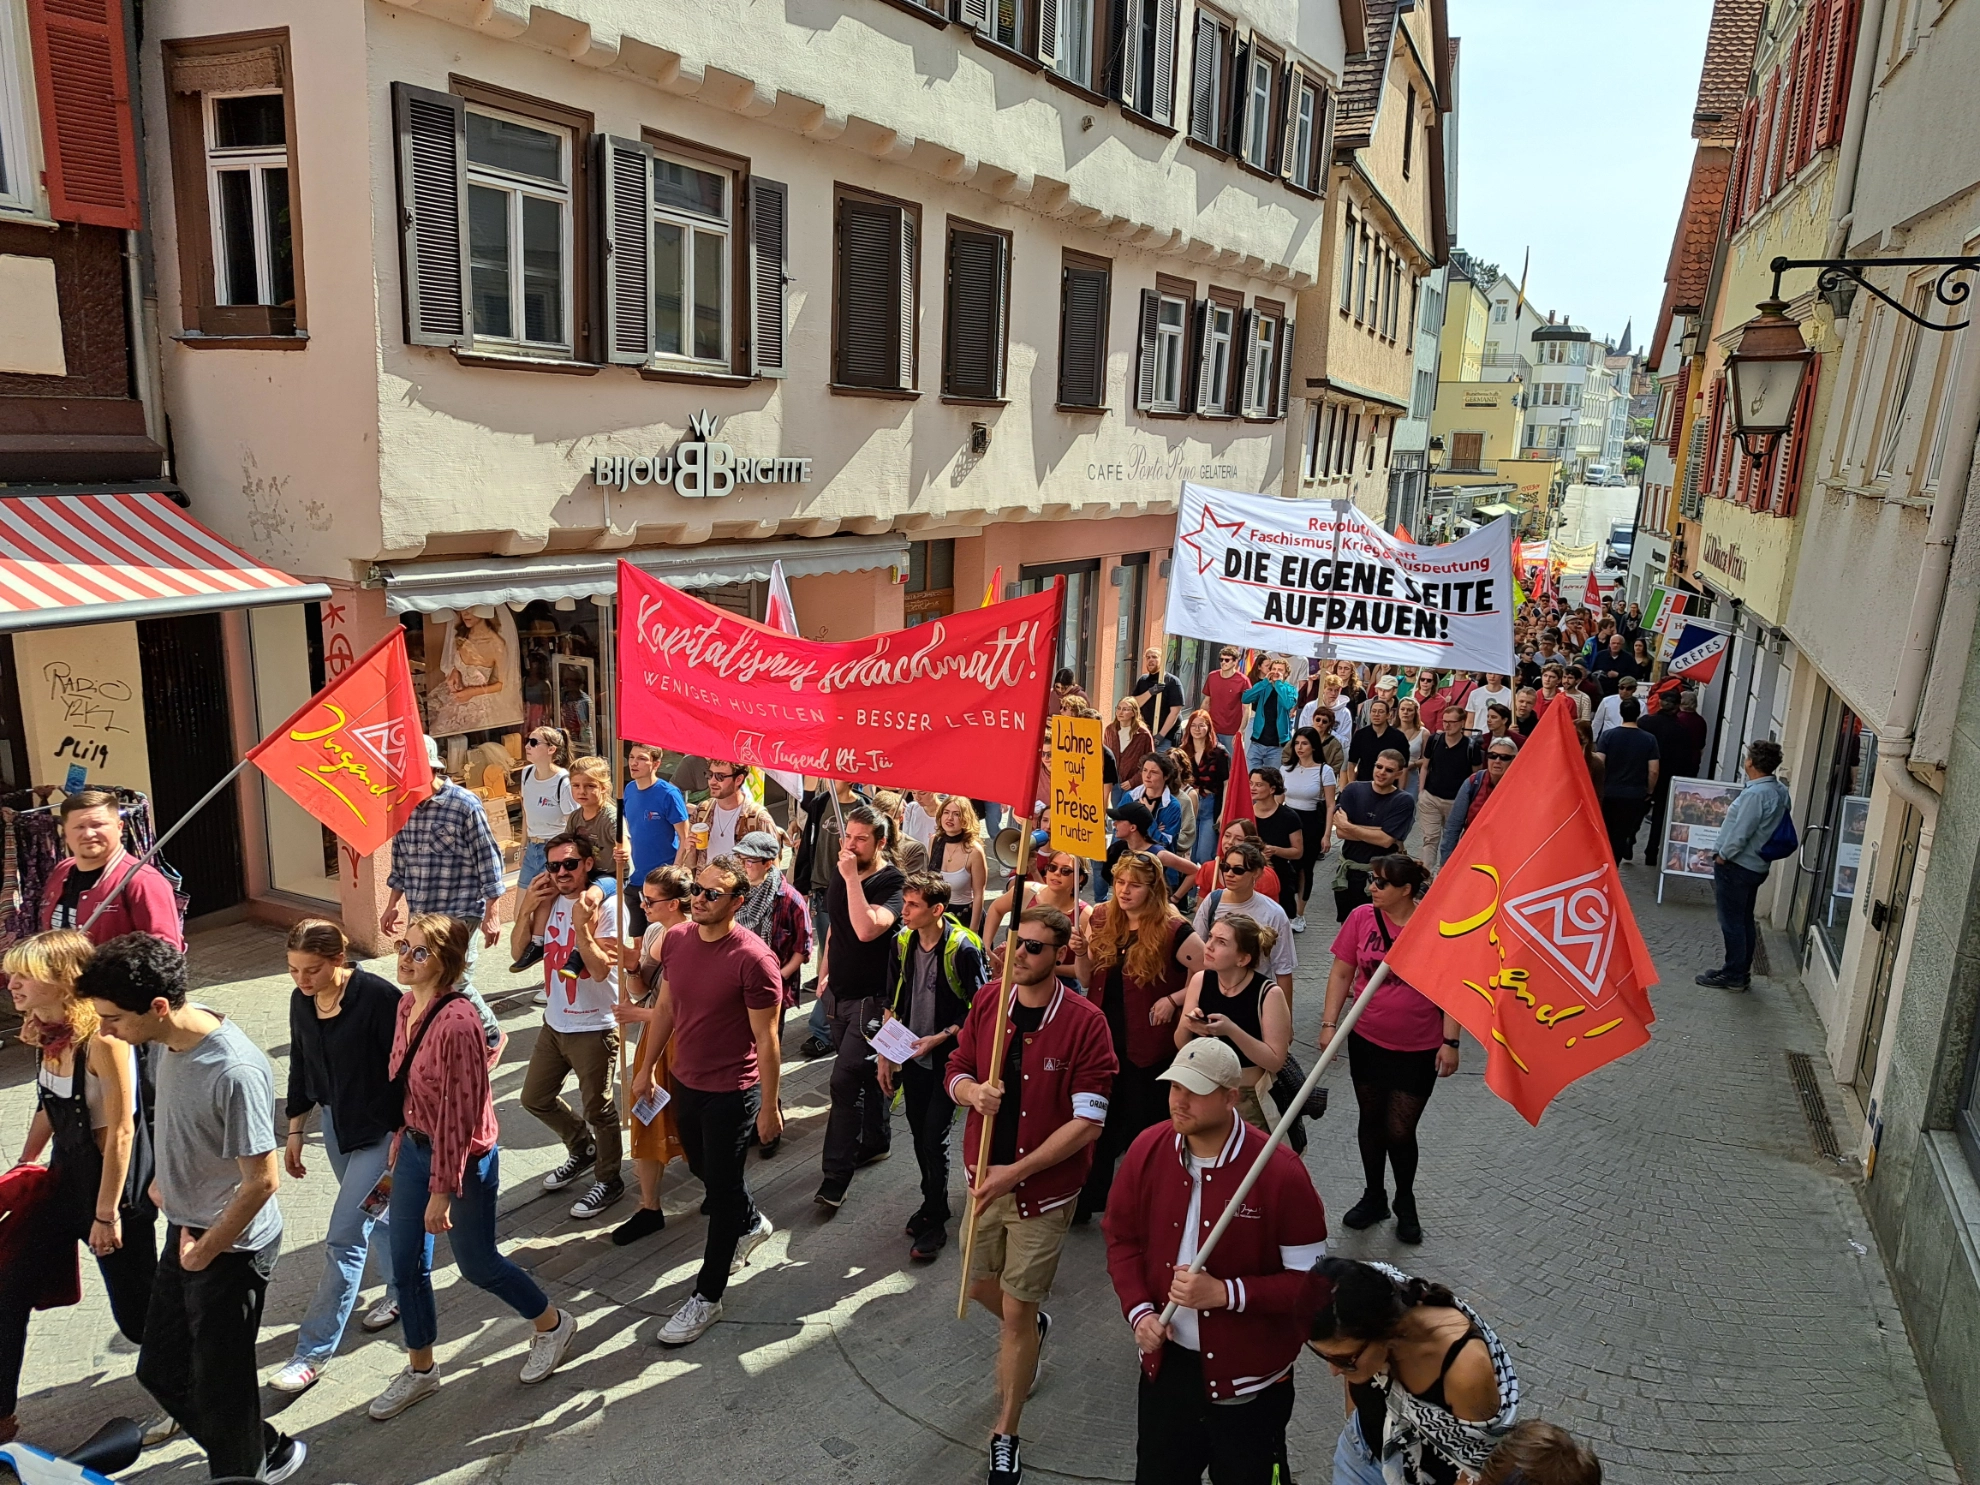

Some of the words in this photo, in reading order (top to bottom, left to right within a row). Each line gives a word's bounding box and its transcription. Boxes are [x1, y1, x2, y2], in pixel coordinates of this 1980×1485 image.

[594, 456, 673, 493] BIJOU
[1087, 461, 1123, 481] CAFÉ
[1199, 464, 1238, 480] GELATERIA
[1249, 529, 1337, 553] Faschismus,
[1341, 537, 1380, 558] Krieg
[1394, 556, 1491, 574] Ausbeutung
[1224, 547, 1271, 584] DIE
[1280, 555, 1396, 598] EIGENE
[1404, 577, 1495, 613] SEITE
[1263, 591, 1449, 640] AUFBAUEN!
[1655, 596, 1673, 627] EIS
[636, 594, 819, 692] Kapitalismus
[817, 620, 1040, 694] schachmatt!
[643, 670, 723, 707] WENIGER
[729, 697, 826, 723] HUSTLEN
[856, 708, 933, 732] BESSER
[945, 708, 1026, 732] LEBEN
[1057, 719, 1095, 755] Löhne
[290, 703, 411, 813] Jugend!
[768, 740, 831, 772] Jugend
[1064, 756, 1086, 782] rauf
[1056, 788, 1099, 824] Preise
[1060, 821, 1094, 843] runter
